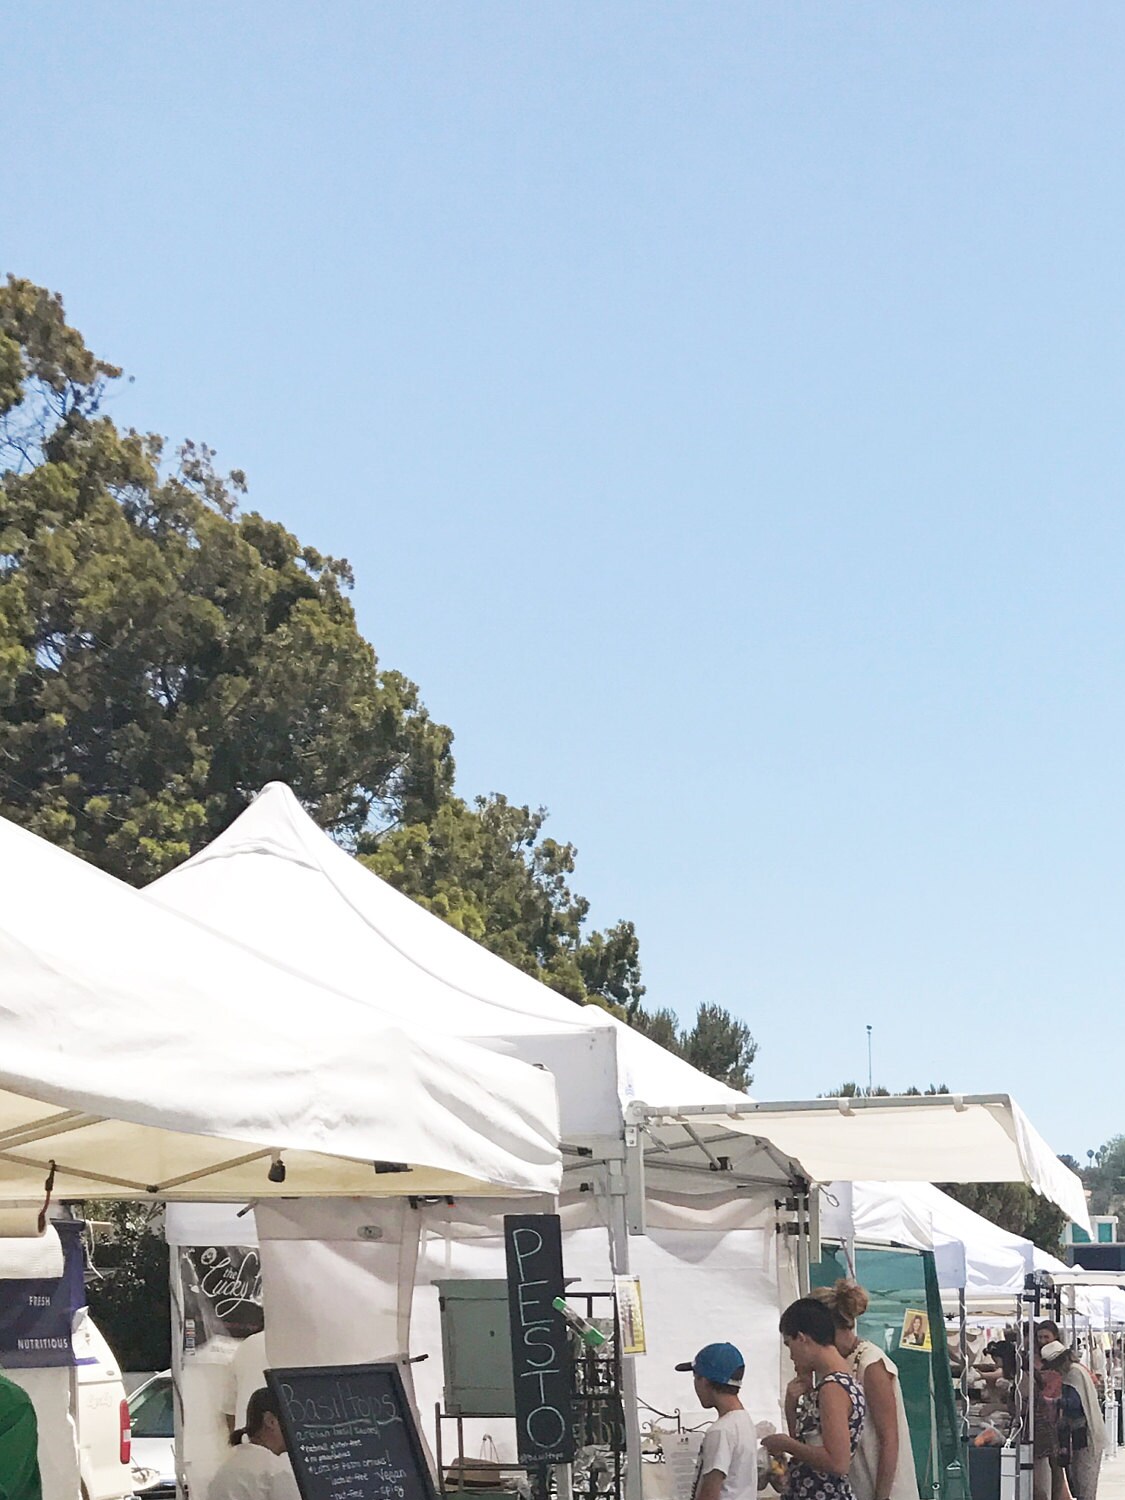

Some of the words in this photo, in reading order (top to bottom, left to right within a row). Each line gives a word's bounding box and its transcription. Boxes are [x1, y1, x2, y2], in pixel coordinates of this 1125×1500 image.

[223, 1267, 238, 1280] the
[28, 1295, 51, 1306] FRESH
[17, 1338, 68, 1349] NUTRITIOUS
[512, 1228, 566, 1448] PESTO
